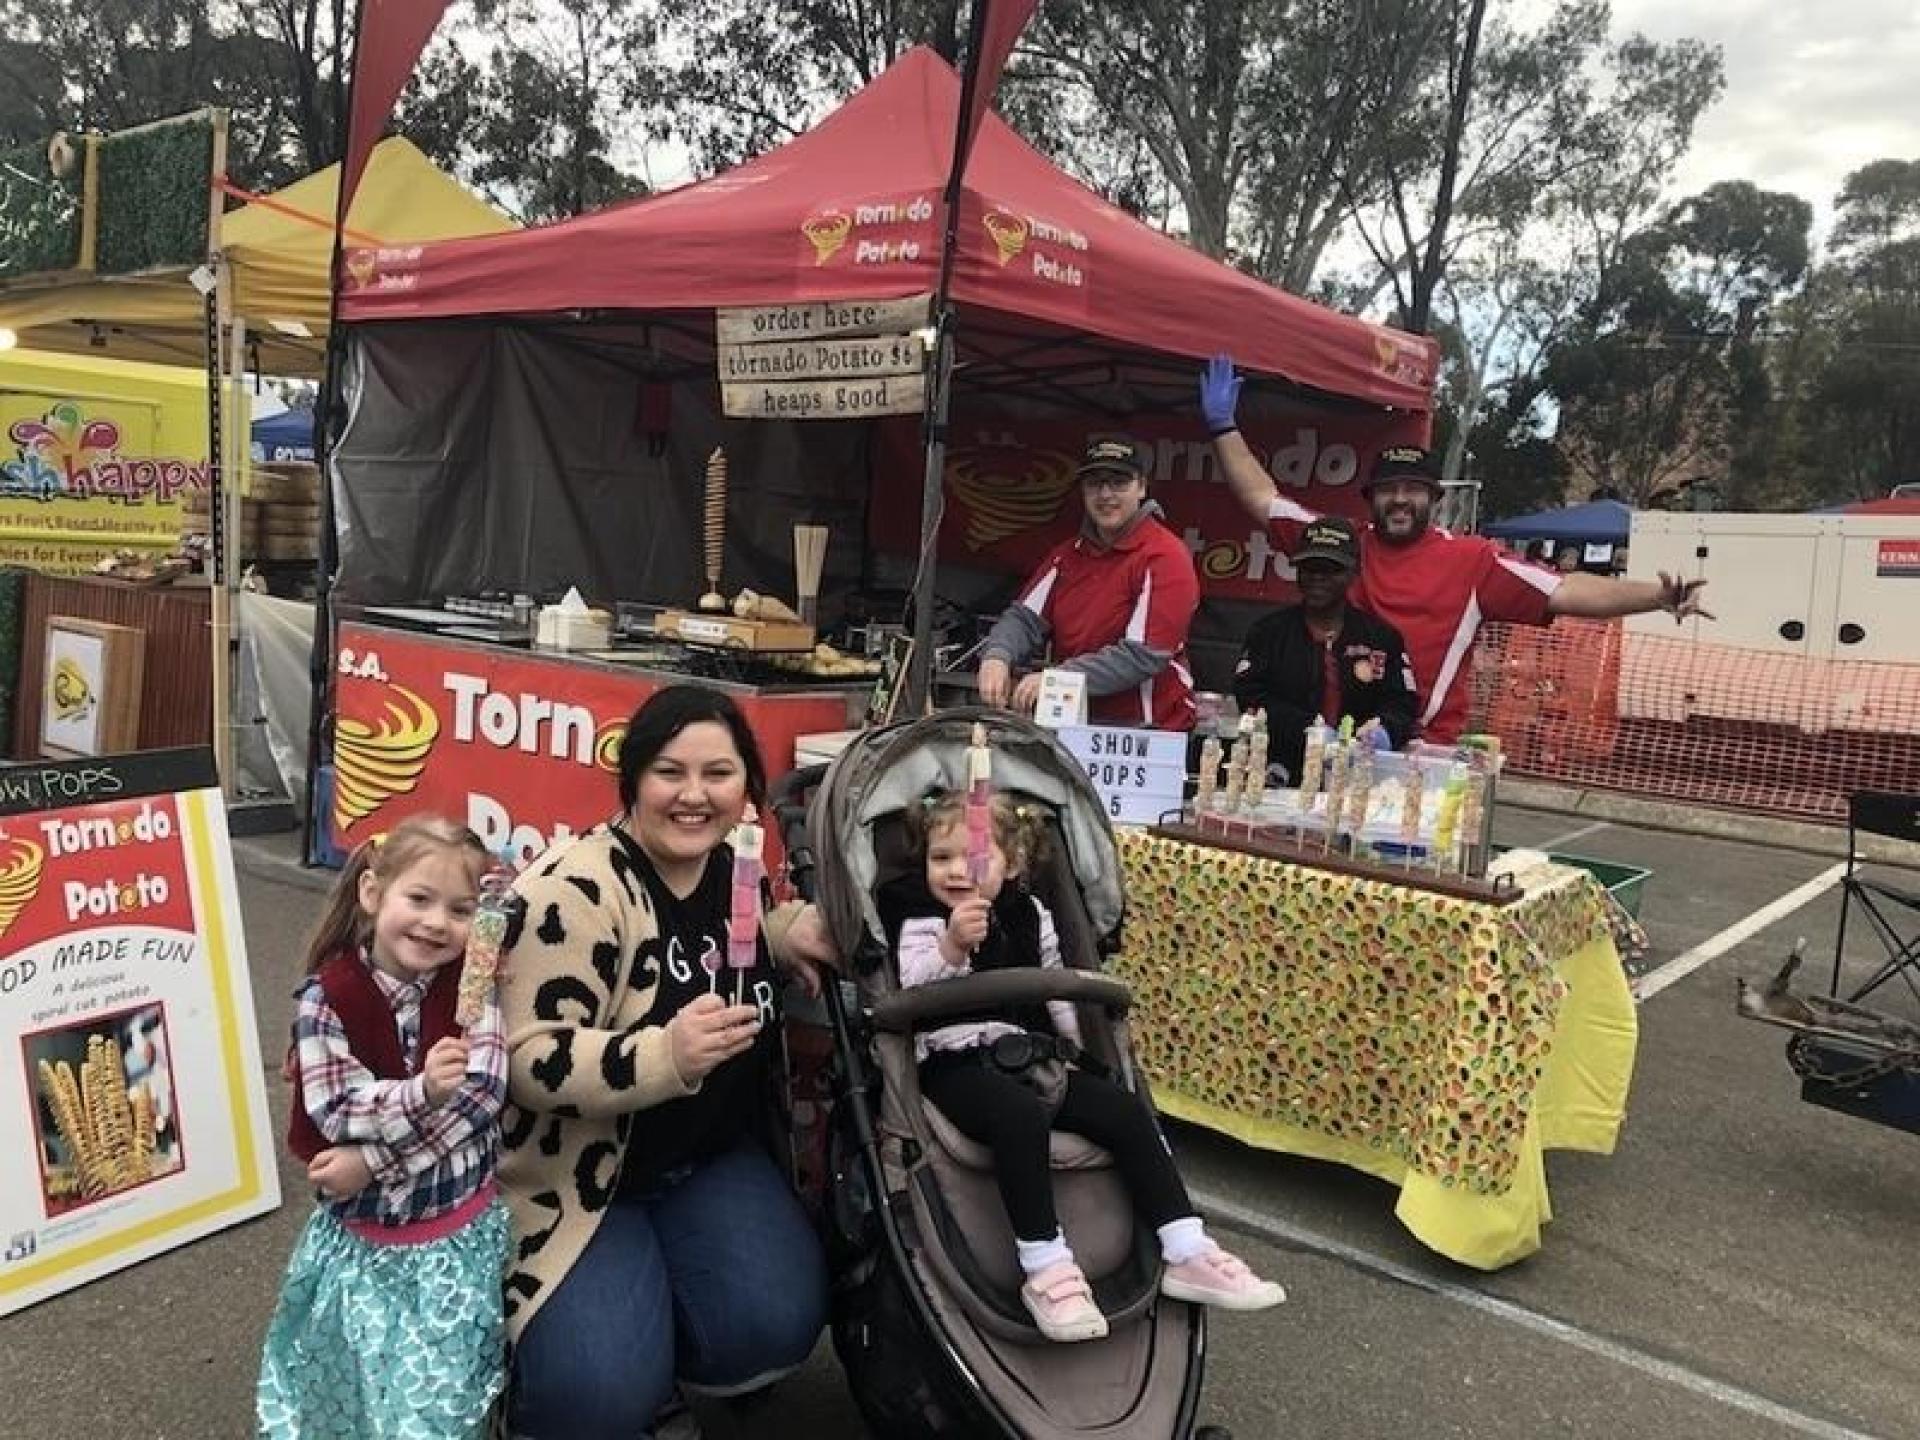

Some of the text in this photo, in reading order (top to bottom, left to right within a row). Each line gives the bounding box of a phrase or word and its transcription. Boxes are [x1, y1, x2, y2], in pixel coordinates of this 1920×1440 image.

[753, 303, 875, 333] order here
[816, 344, 885, 371] Potato
[764, 380, 889, 416] heaps good
[1091, 733, 1149, 757] SHOW
[41, 767, 123, 798] POPS
[1089, 763, 1146, 788] POPS
[40, 803, 171, 857] Tornado
[64, 873, 169, 922] Potato
[52, 938, 130, 972] MADE
[142, 937, 195, 963] FUN
